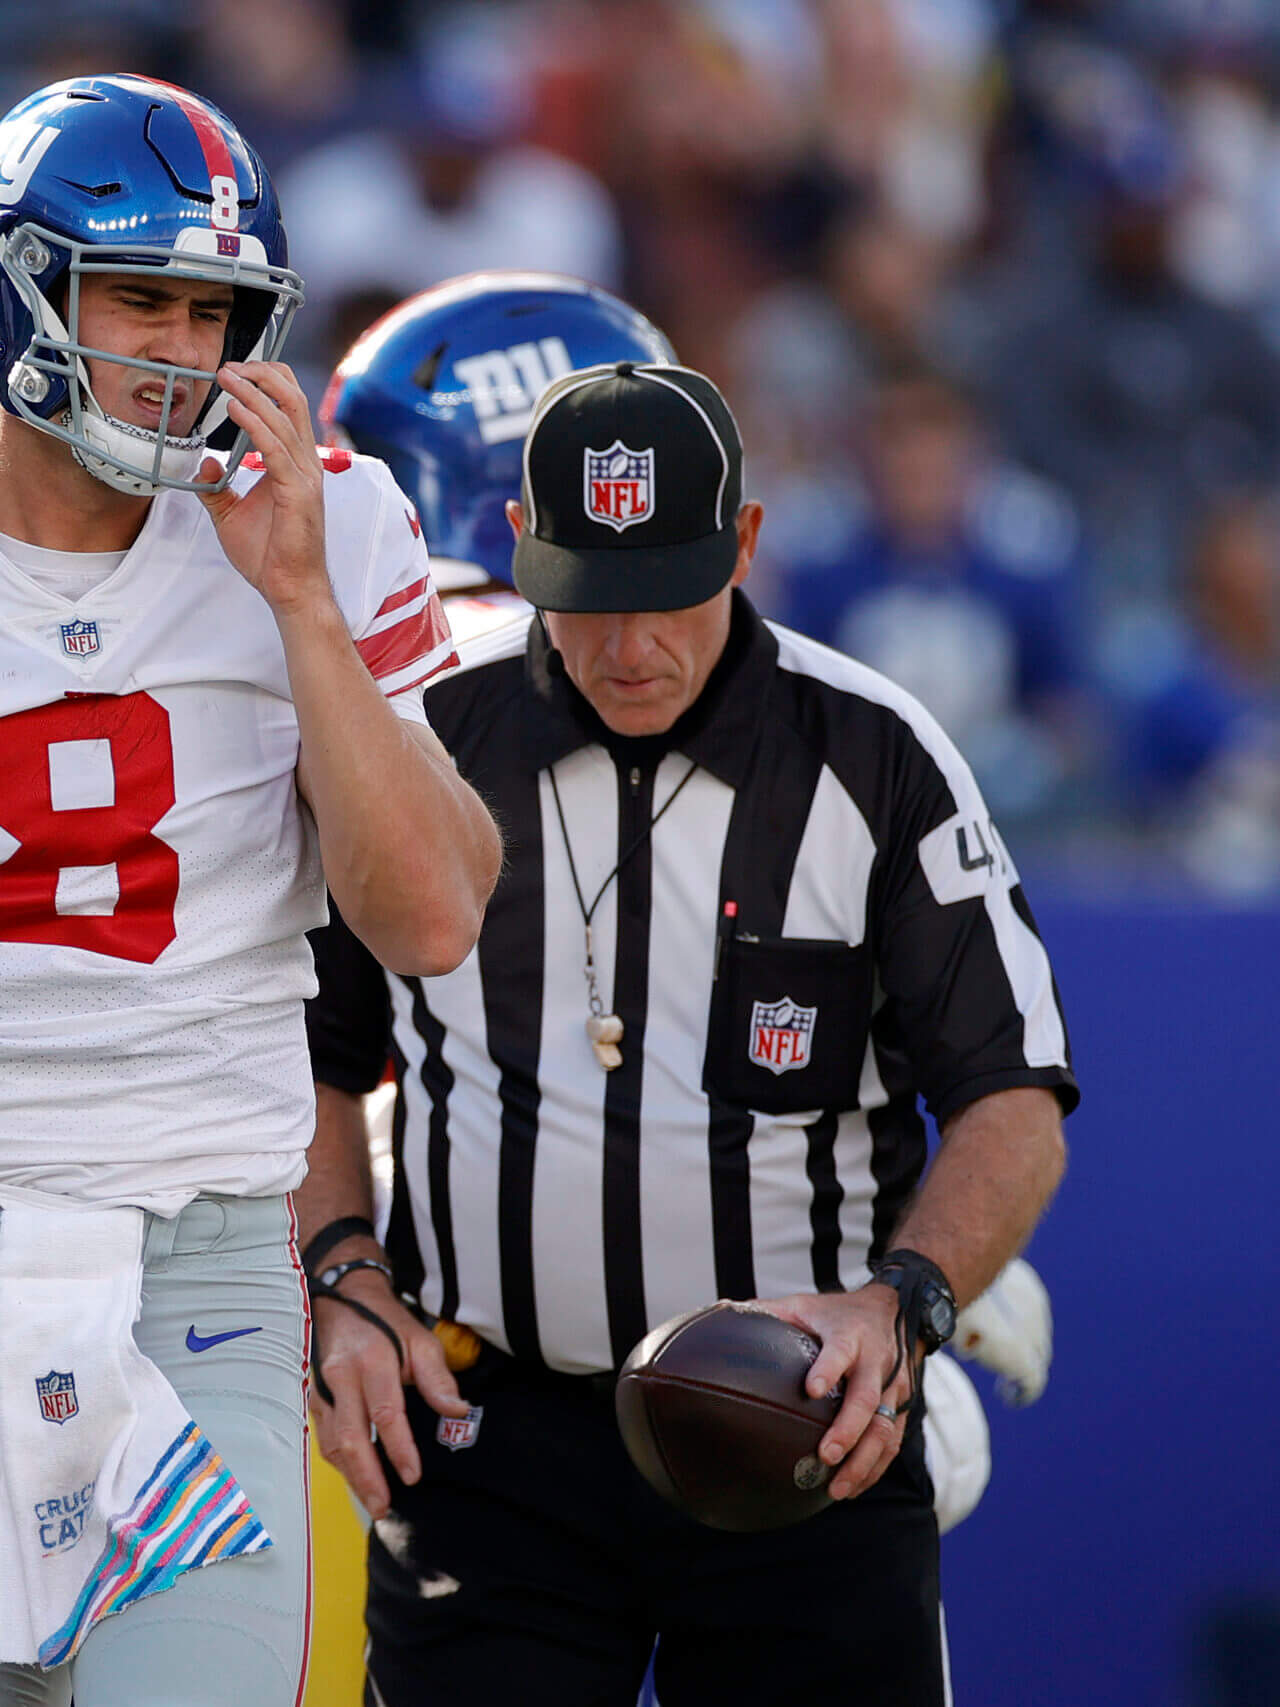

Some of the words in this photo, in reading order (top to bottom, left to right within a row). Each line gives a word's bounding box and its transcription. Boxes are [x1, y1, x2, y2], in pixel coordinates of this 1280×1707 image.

[211, 174, 239, 230] 8
[592, 481, 646, 519] NFL
[66, 635, 96, 653] NFL
[955, 820, 1008, 878] 4
[755, 1027, 805, 1066] NFL
[42, 1392, 76, 1420] NFL
[441, 1421, 472, 1443] NFL
